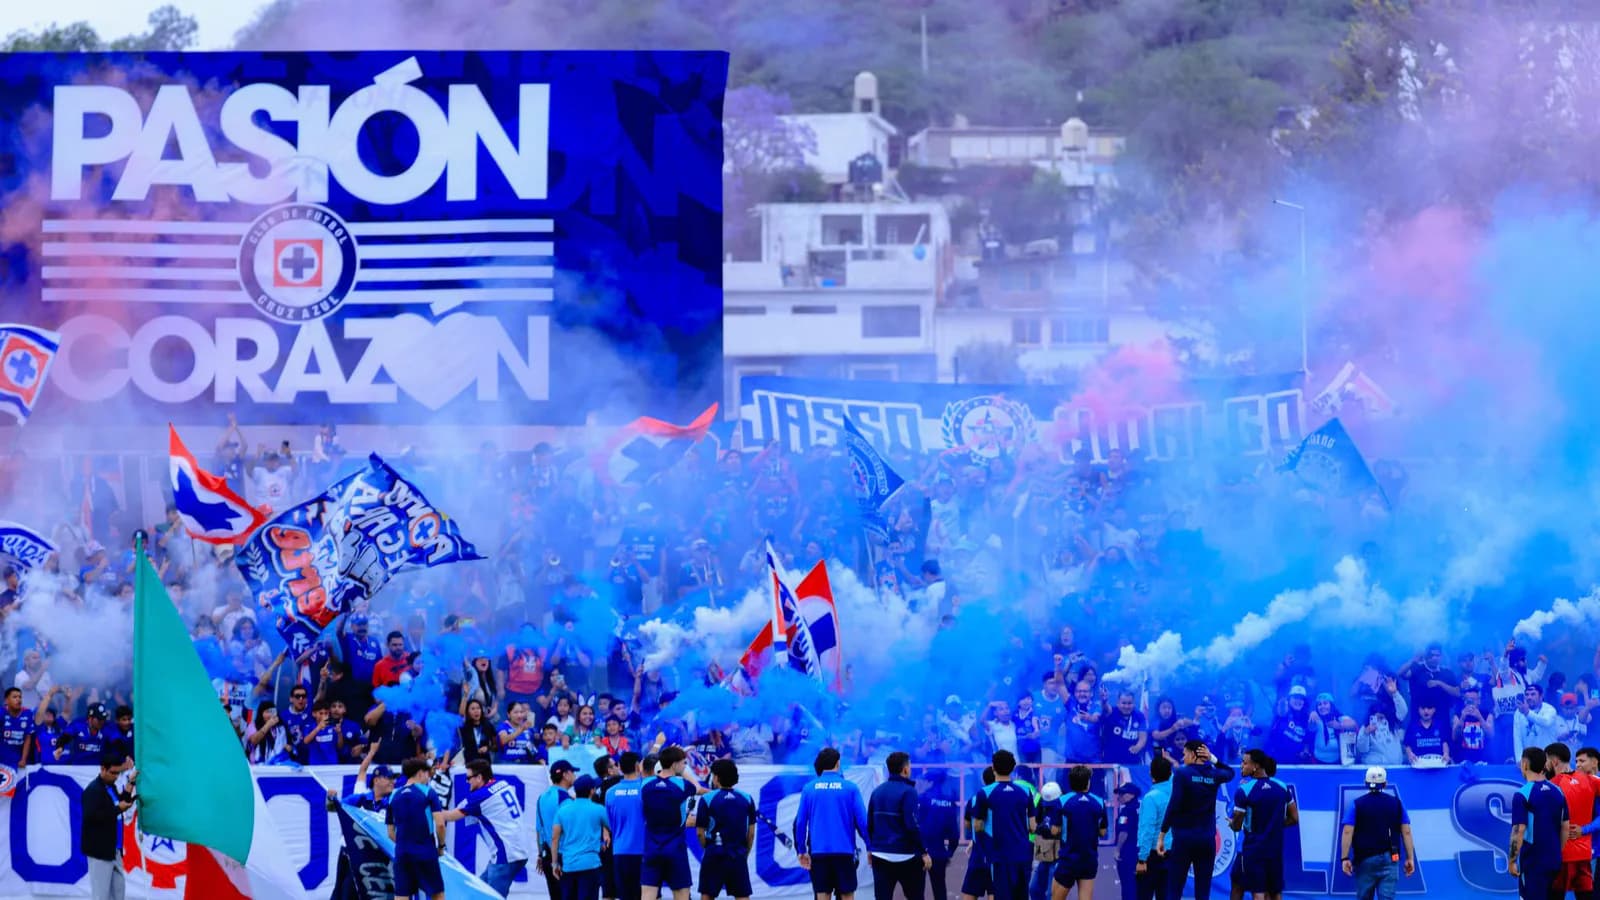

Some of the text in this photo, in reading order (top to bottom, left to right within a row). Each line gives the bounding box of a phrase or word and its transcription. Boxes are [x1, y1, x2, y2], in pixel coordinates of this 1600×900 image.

[50, 56, 550, 205] PASIÓN
[249, 216, 275, 245] CLUB
[281, 208, 298, 220] DE
[257, 294, 340, 319] CRUZ AZUL
[741, 388, 924, 455] JASSO
[500, 790, 520, 819] 9
